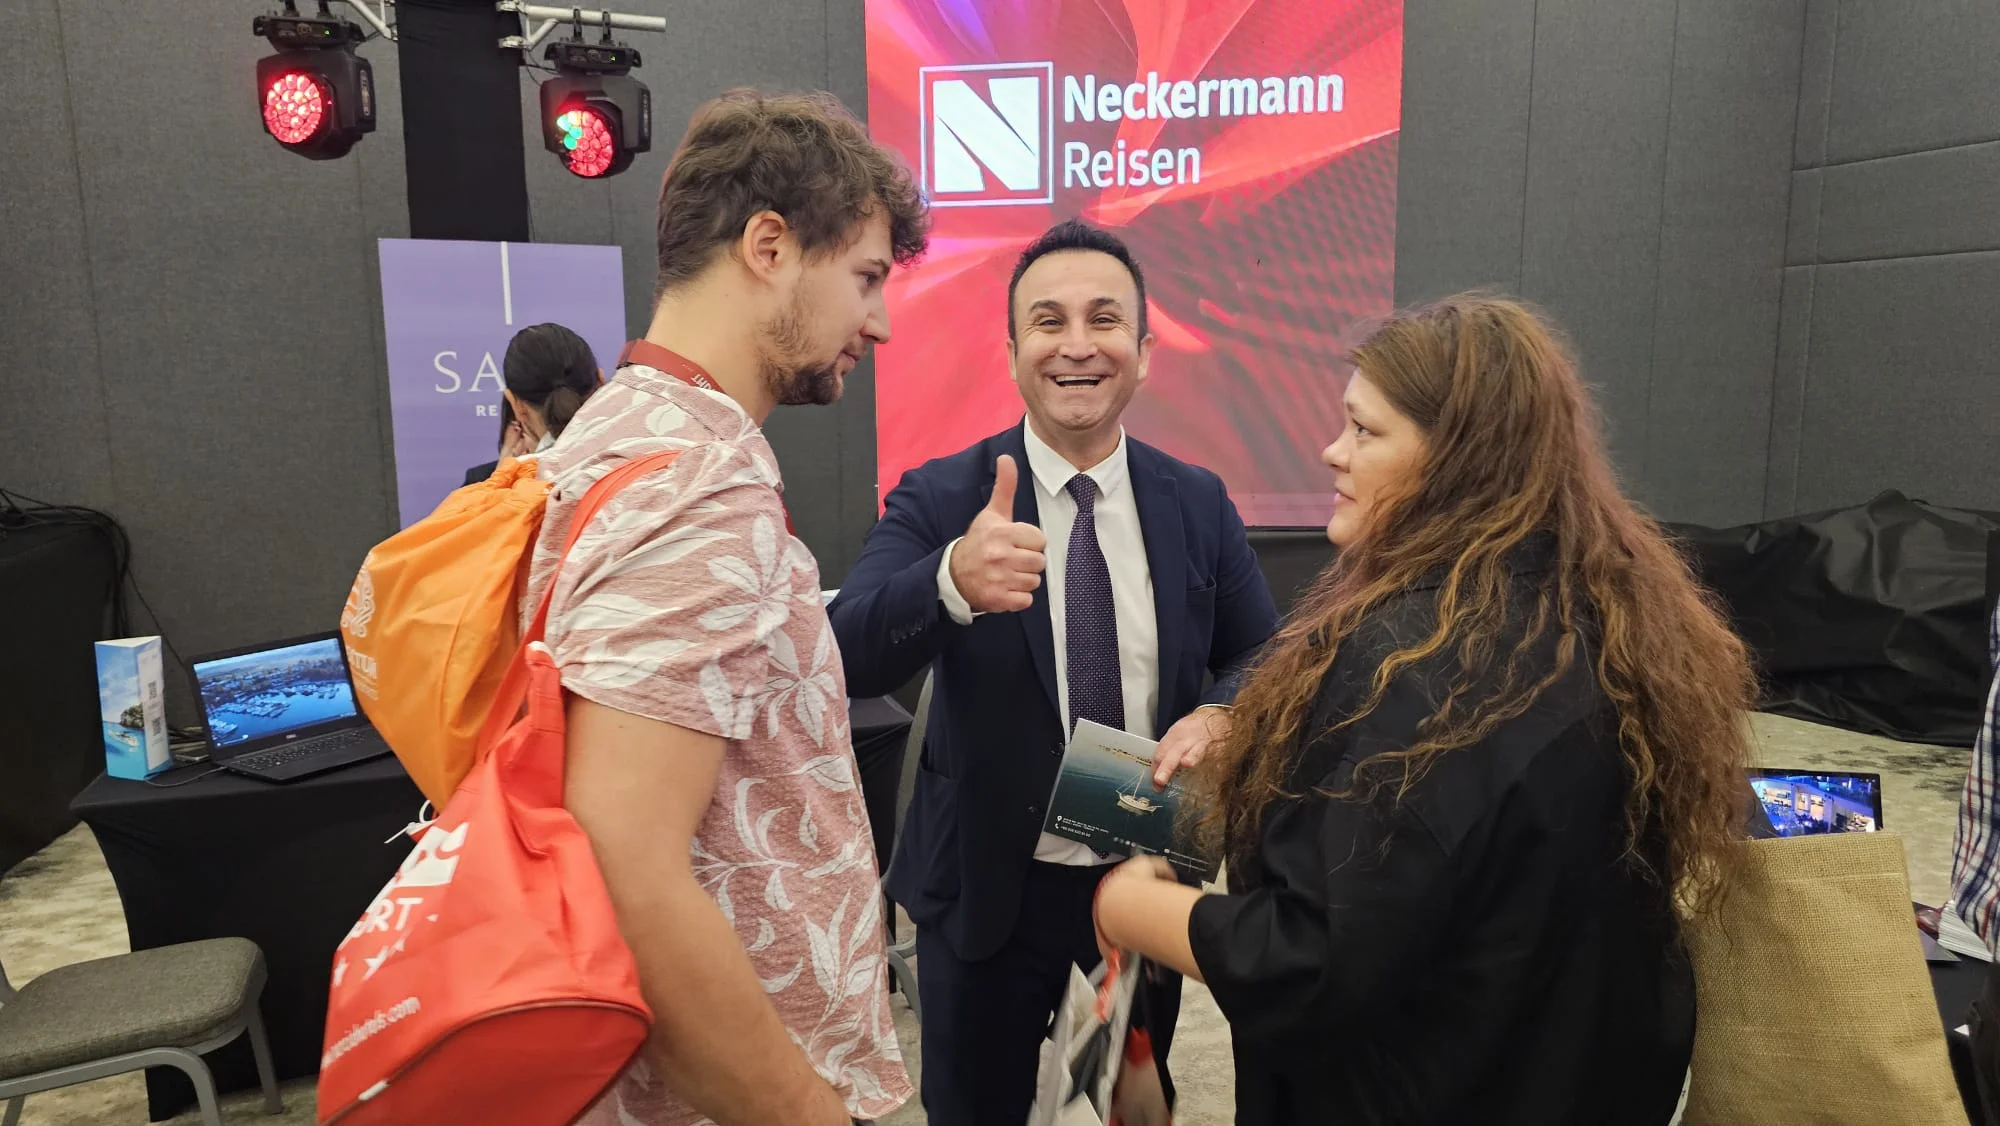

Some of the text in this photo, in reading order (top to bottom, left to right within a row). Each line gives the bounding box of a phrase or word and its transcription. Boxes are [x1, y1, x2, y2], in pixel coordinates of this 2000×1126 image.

[1064, 71, 1344, 123] Neckermann
[1064, 140, 1201, 188] Reisen
[433, 350, 507, 393] SA
[475, 404, 499, 417] RE
